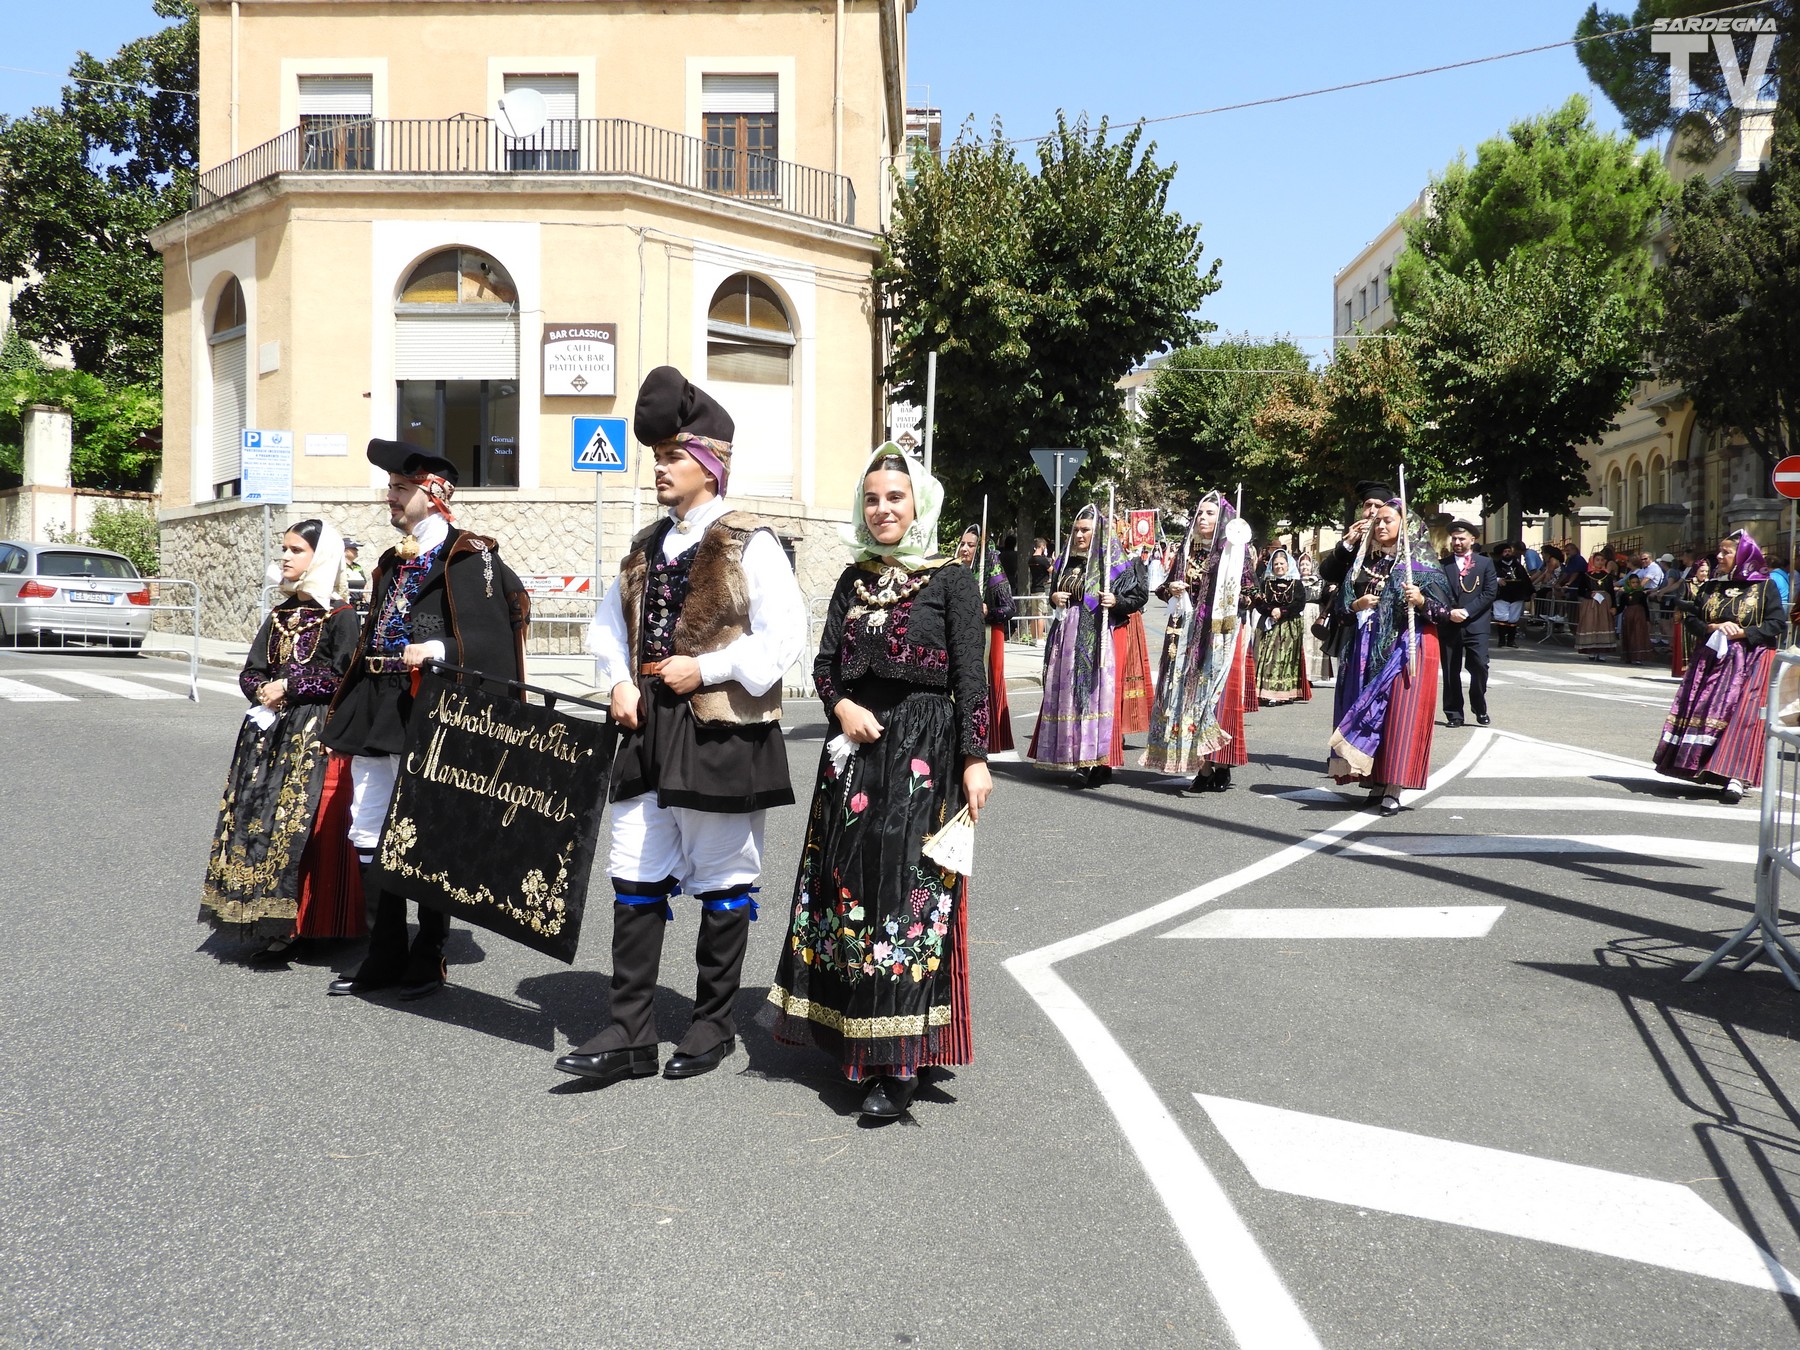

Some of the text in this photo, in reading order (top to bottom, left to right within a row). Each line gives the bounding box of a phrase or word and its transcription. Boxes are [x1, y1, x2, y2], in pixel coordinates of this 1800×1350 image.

[549, 329, 610, 340] BAR CLASSICO
[554, 354, 605, 362] SNACK BAR
[549, 364, 610, 372] PIATTI VELOCI
[247, 432, 260, 447] P
